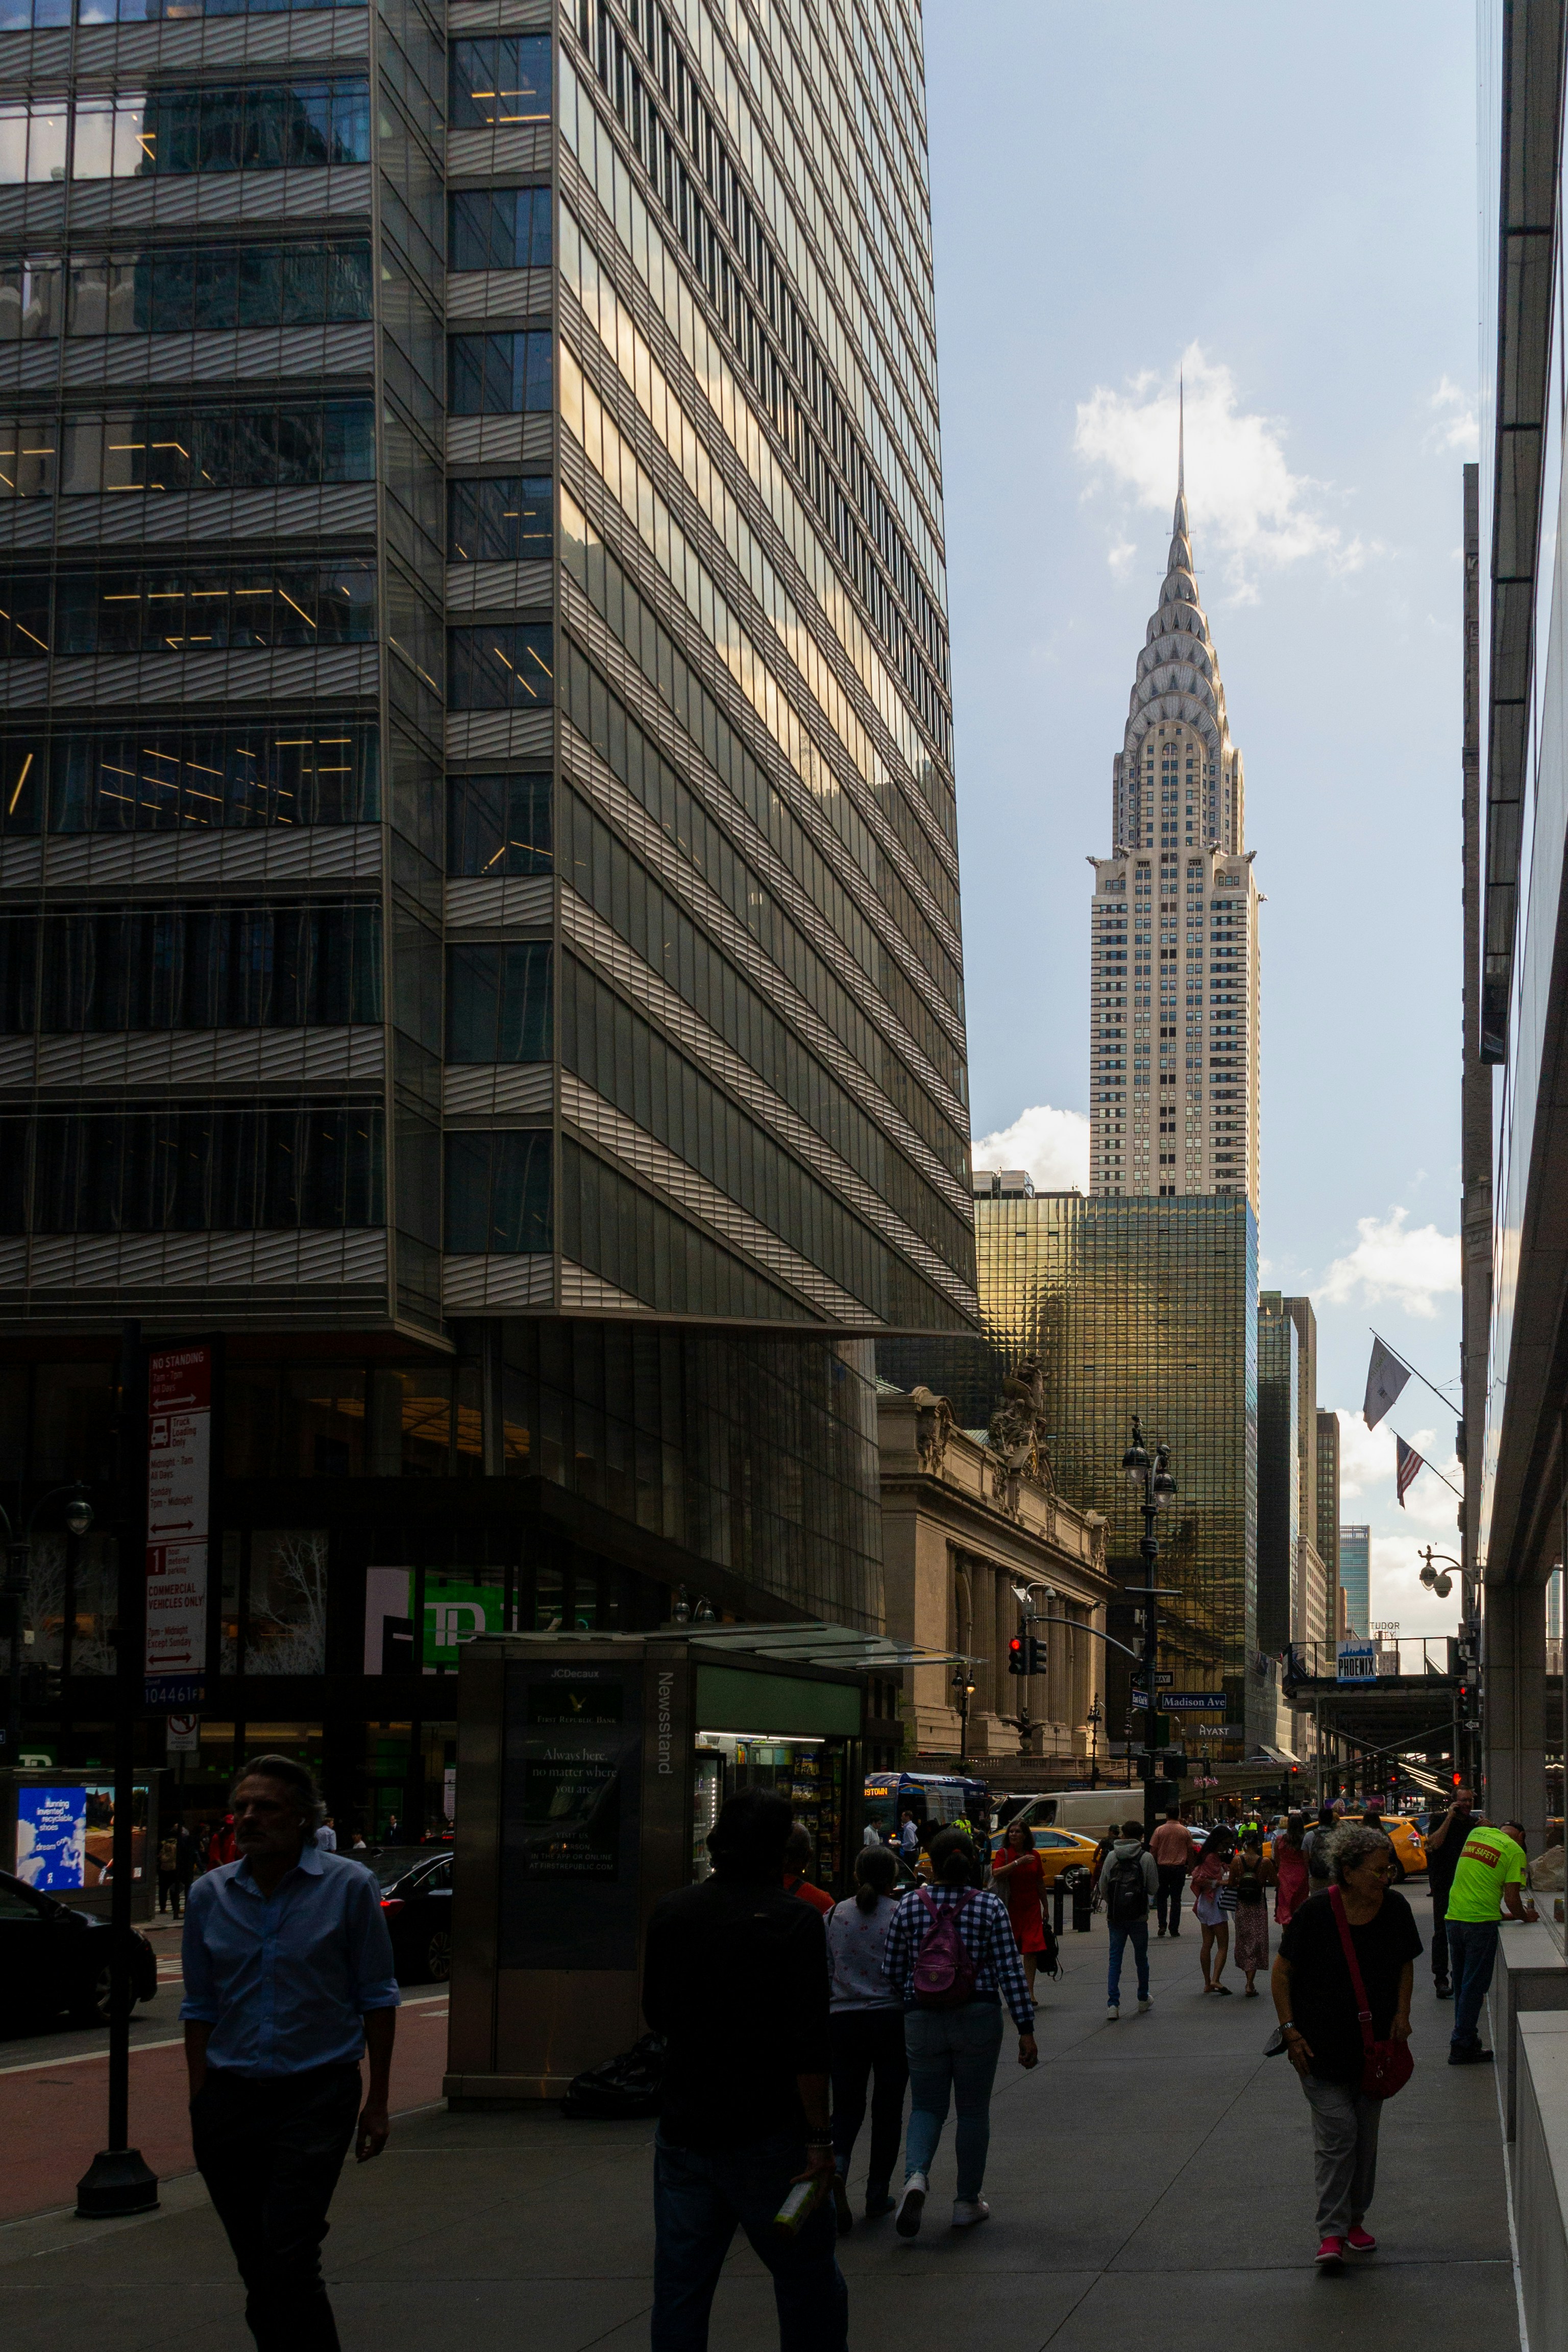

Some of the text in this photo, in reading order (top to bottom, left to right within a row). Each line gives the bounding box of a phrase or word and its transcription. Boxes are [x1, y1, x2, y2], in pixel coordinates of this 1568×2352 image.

[153, 1351, 204, 1369] NO STANDING
[153, 1374, 165, 1382] 7am
[170, 1370, 183, 1380] 7pm
[161, 1384, 176, 1394] Days
[173, 1417, 190, 1427] Truck
[173, 1428, 197, 1437] Loading
[173, 1438, 186, 1448] Only
[151, 1459, 175, 1469] Midnight
[181, 1456, 193, 1465] 7am
[159, 1471, 173, 1480] Days
[150, 1488, 172, 1497] Sunday
[150, 1499, 162, 1509] 7pm
[168, 1496, 193, 1506] Midnight
[153, 1549, 159, 1573] 1
[168, 1556, 189, 1565] metered
[168, 1567, 186, 1576] parking
[149, 1583, 195, 1597] COMMERCIAL
[149, 1595, 203, 1609] VEHICLES ONLY
[148, 1628, 160, 1637] 7pm
[165, 1625, 188, 1636] Midnight
[148, 1637, 191, 1649] Except Sunday
[551, 1669, 600, 1678] JCDecaux
[1338, 1658, 1374, 1677] PHOENIX
[1163, 1698, 1225, 1706] Madison Ave
[537, 1715, 556, 1723] FIRST
[596, 1715, 617, 1724] BANK
[658, 1672, 674, 1774] Newsstand
[543, 1748, 608, 1764] Always here,
[549, 1768, 583, 1777] matter
[586, 1765, 617, 1777] where
[556, 1785, 575, 1797] you
[36, 1807, 64, 1816] invented
[41, 1814, 73, 1824] recyclable
[36, 1843, 56, 1851] dream
[1476, 1848, 1498, 1862] SAFETY
